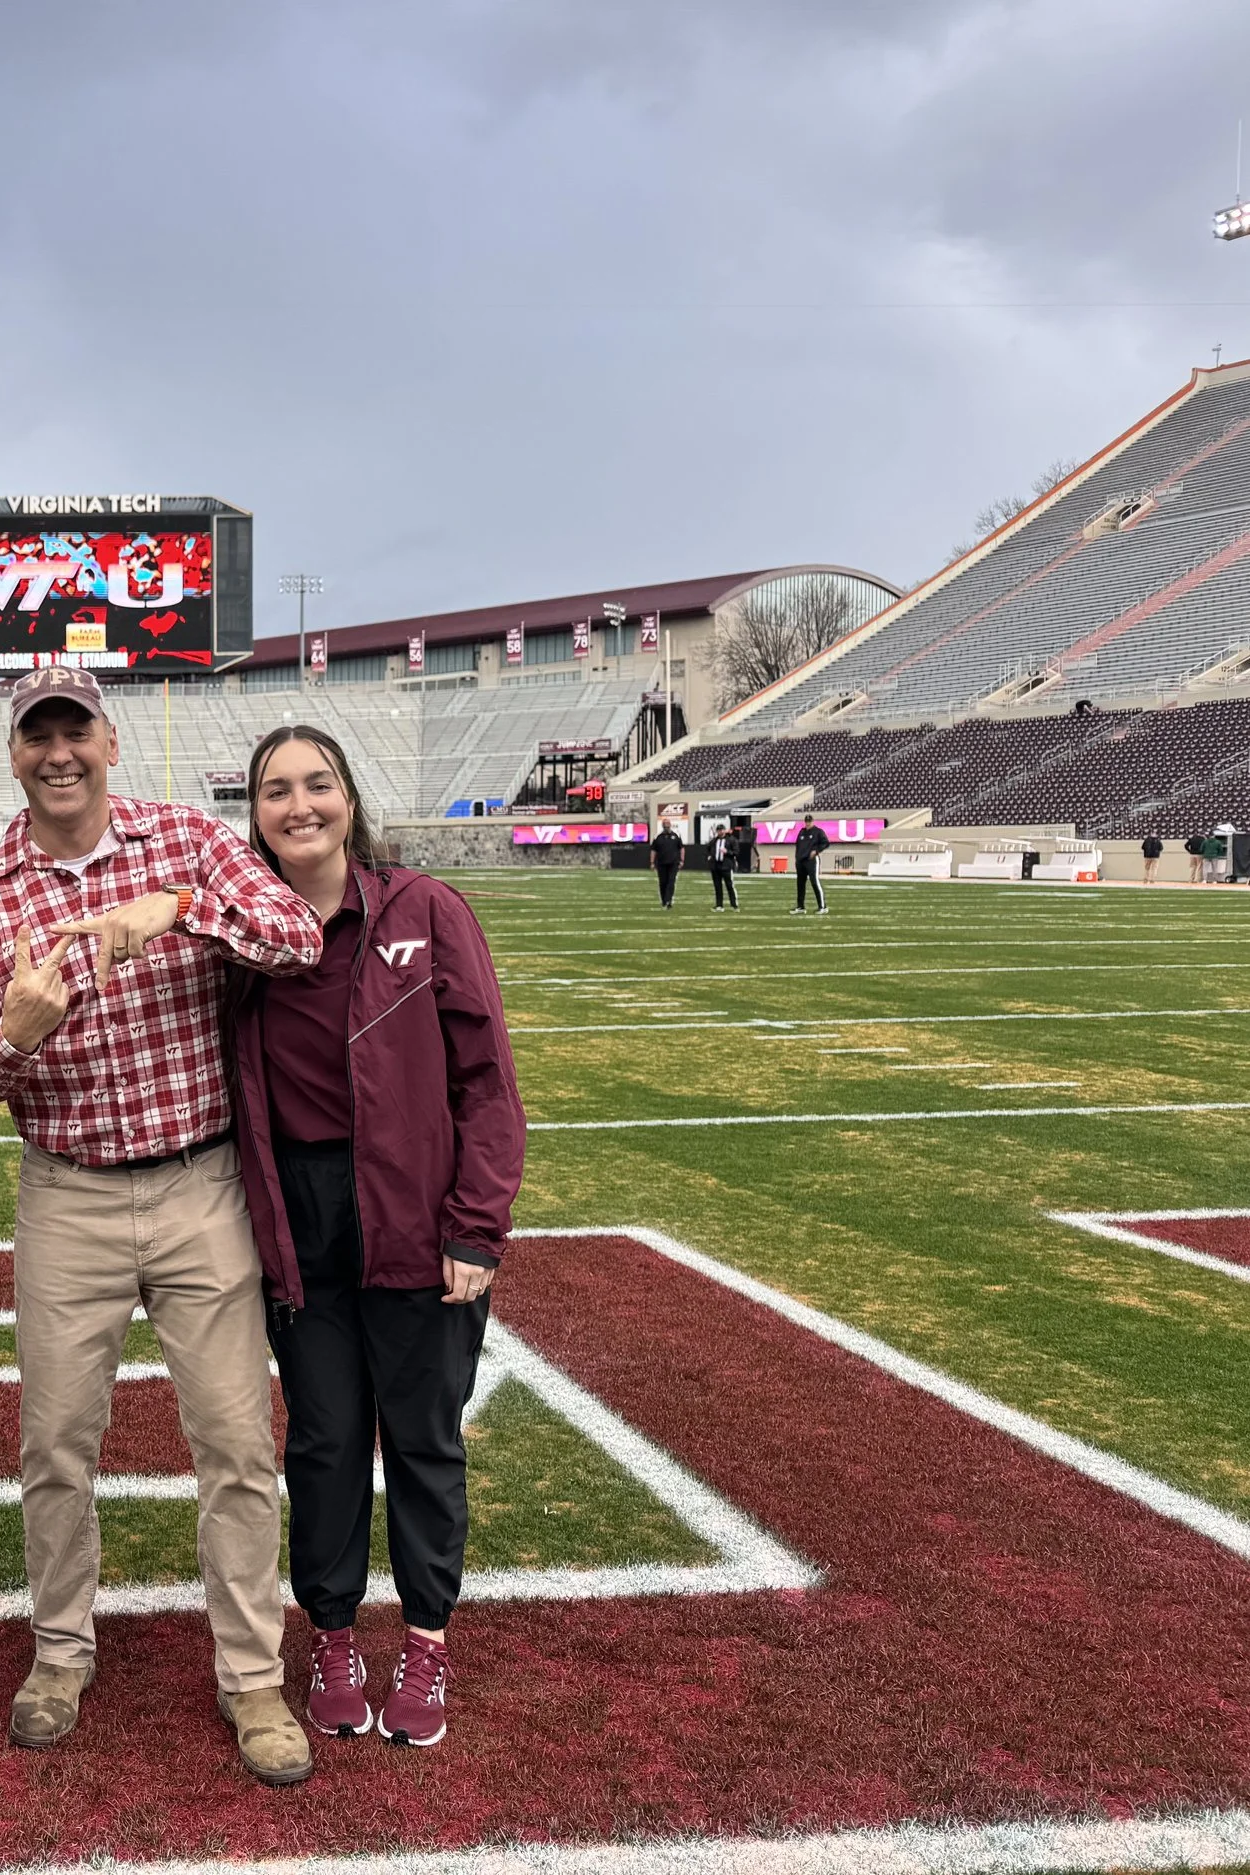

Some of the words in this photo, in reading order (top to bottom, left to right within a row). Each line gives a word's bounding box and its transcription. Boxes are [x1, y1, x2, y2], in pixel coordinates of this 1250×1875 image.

[7, 495, 104, 514] VIRGINIA
[109, 494, 161, 513] TECH
[108, 563, 184, 608] U
[574, 635, 588, 649] 78
[642, 629, 657, 643] 73
[507, 640, 521, 653] 58
[38, 653, 52, 668] TO
[81, 652, 129, 668] STADIUM
[311, 651, 325, 664] 64
[25, 668, 85, 689] VPI
[585, 786, 602, 800] 38
[661, 804, 685, 815] ACC
[533, 826, 562, 842] VT
[612, 823, 634, 842] U
[765, 822, 796, 843] VT
[838, 820, 865, 843] U
[371, 937, 430, 972] VT
[151, 957, 165, 966] VT
[131, 1025, 145, 1034] VT
[85, 1034, 98, 1042] VT
[166, 1047, 180, 1055] VT
[141, 1084, 154, 1092] VT
[92, 1092, 107, 1100] VT
[176, 1107, 190, 1115] VT
